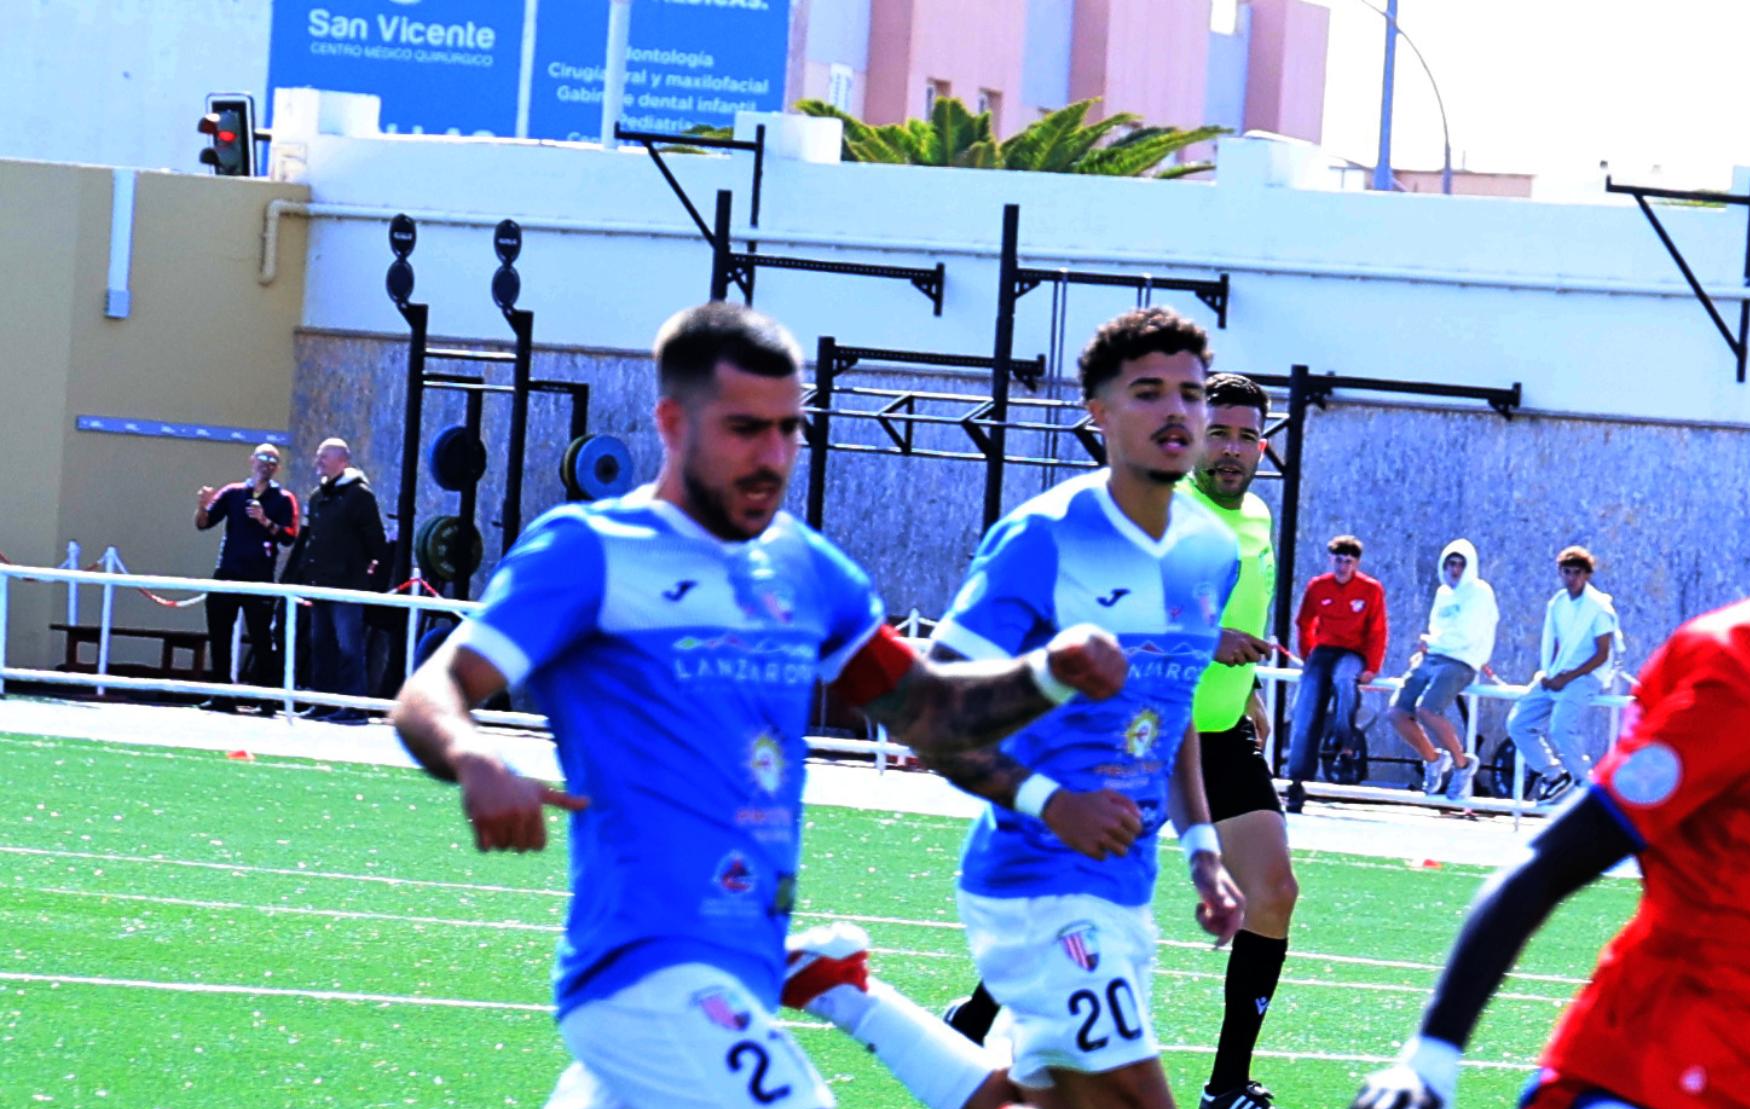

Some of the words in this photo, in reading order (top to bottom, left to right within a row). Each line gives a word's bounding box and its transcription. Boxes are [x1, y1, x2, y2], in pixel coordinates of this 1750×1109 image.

[308, 8, 369, 41] San
[377, 14, 496, 49] Vicente
[310, 41, 362, 57] CENTRO
[624, 70, 647, 85] ral
[651, 73, 661, 89] y
[665, 74, 769, 94] maxilofacial
[638, 92, 693, 111] dental
[1068, 977, 1143, 1052] 20
[726, 1039, 791, 1106] 2
